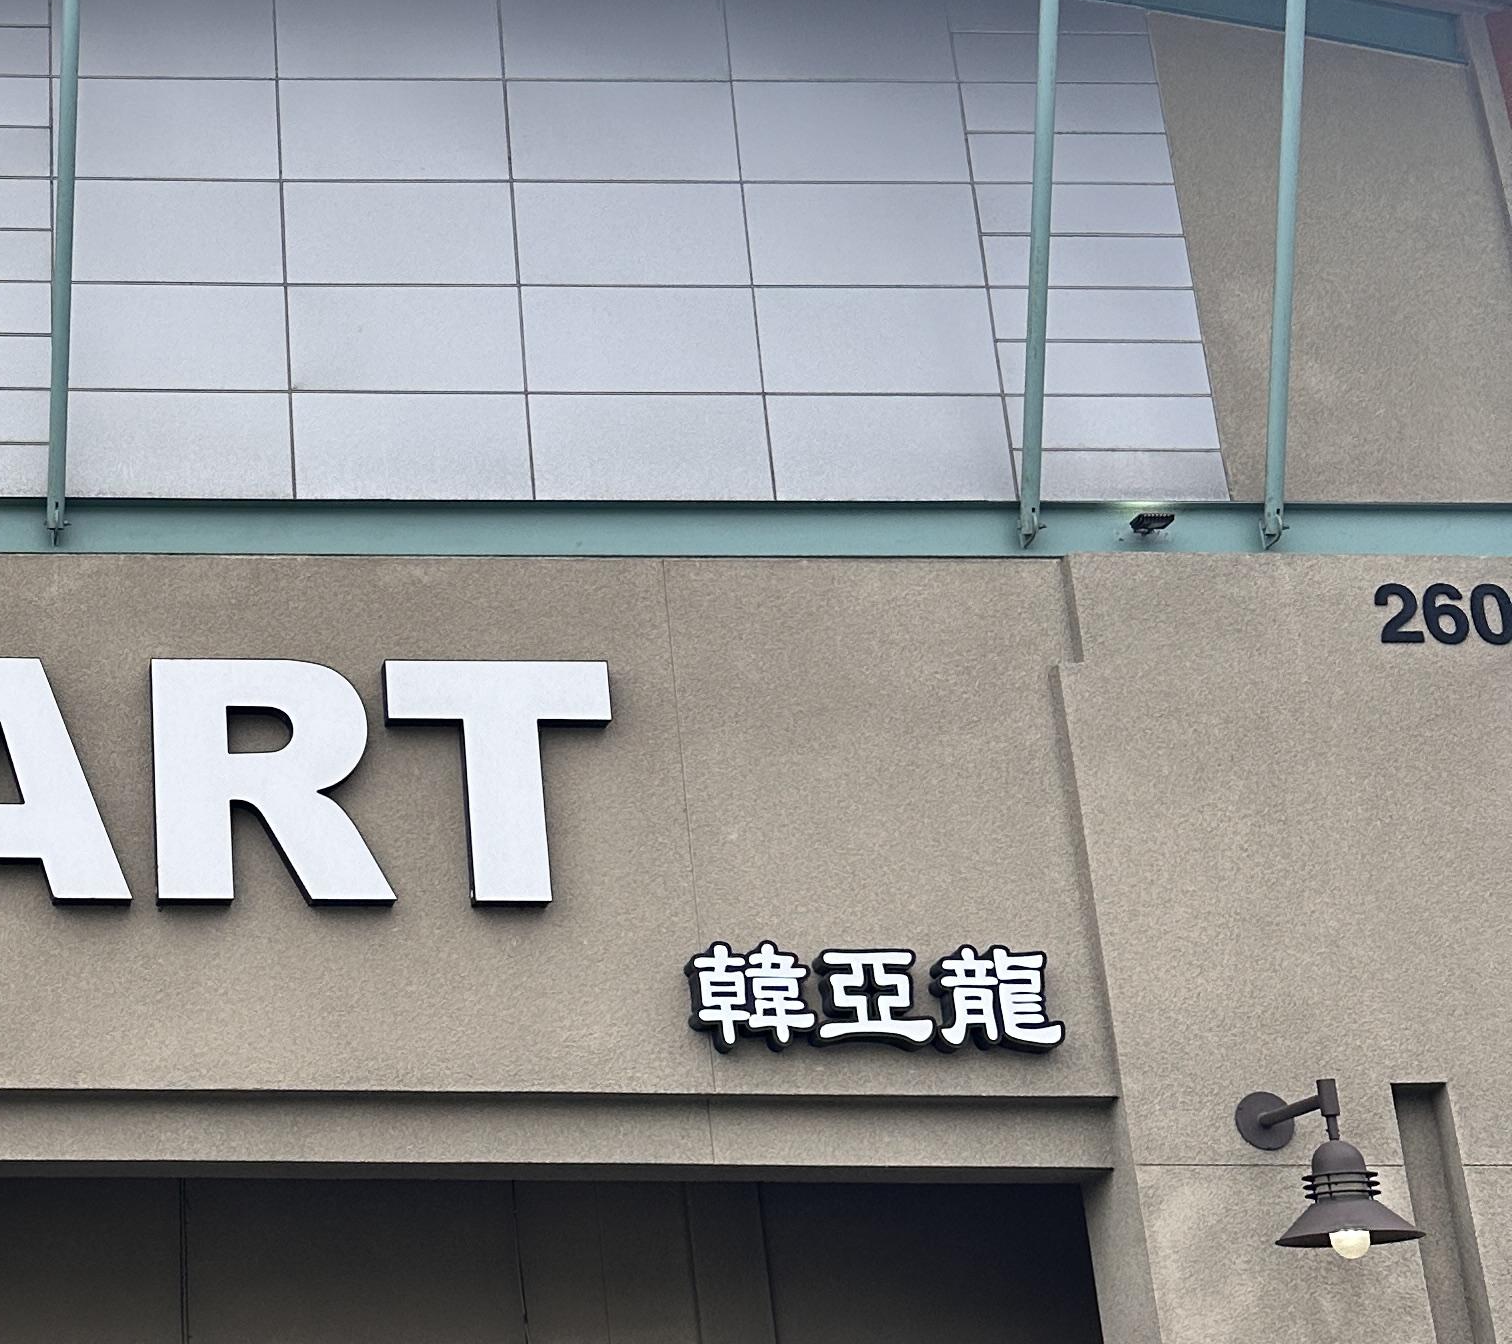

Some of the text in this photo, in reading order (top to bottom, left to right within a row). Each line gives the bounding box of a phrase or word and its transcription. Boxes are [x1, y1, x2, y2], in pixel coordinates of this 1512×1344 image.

[1374, 583, 1512, 645] 260
[684, 940, 1066, 1054] 韓亞龍
